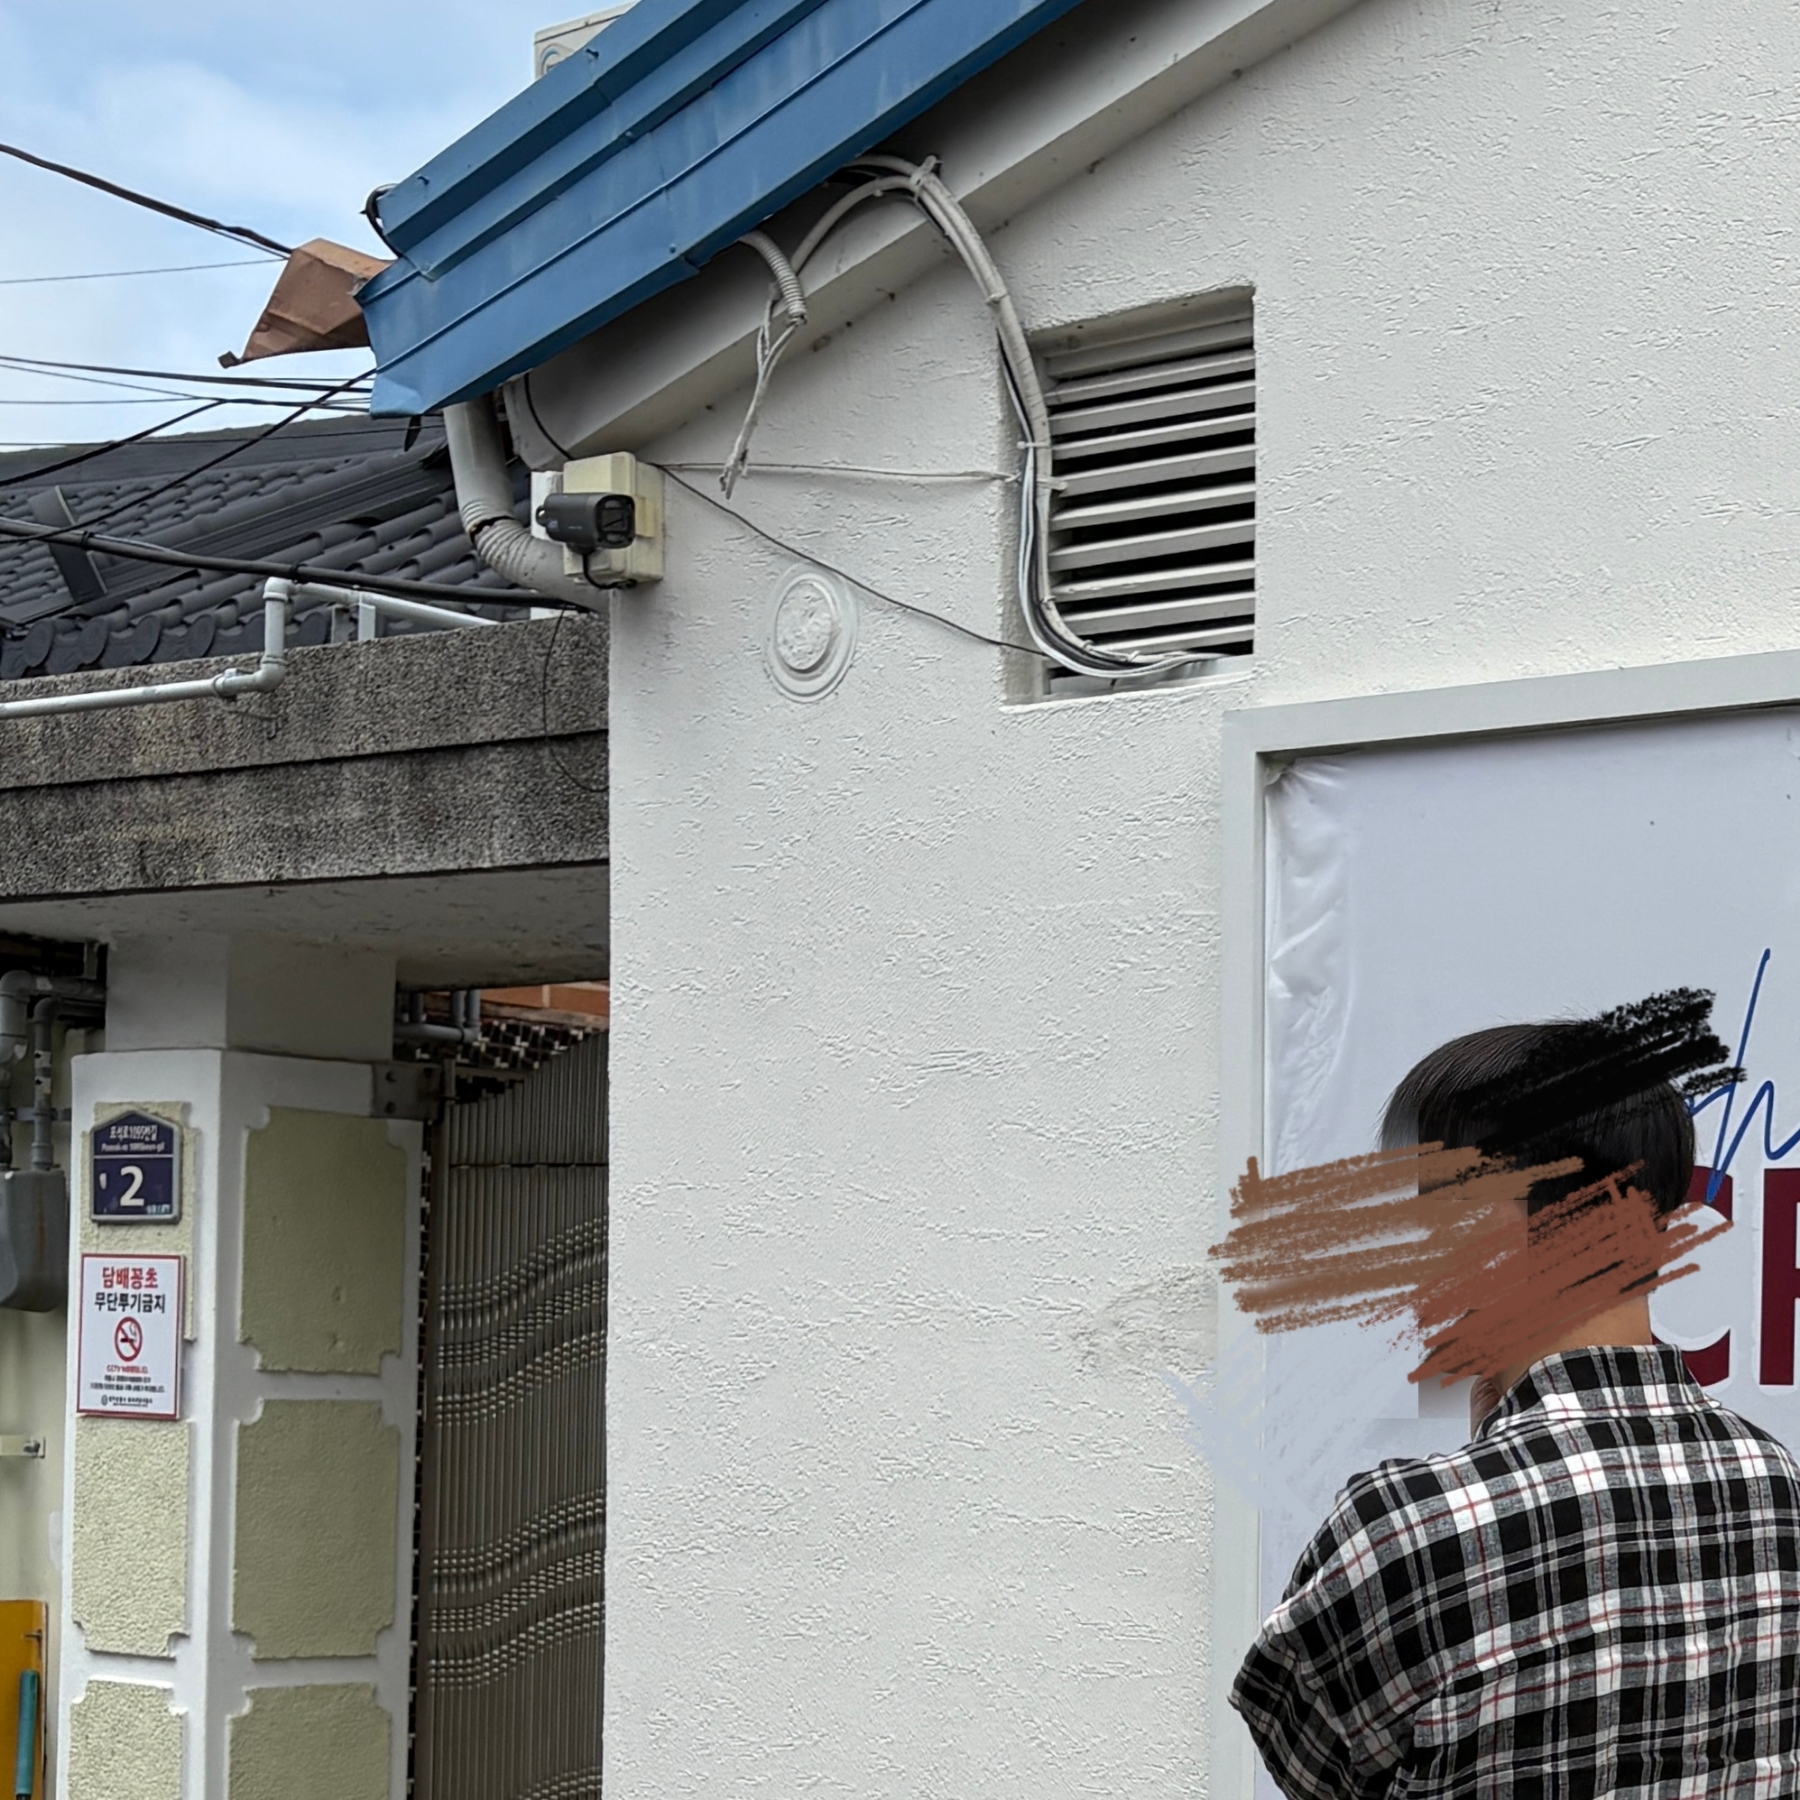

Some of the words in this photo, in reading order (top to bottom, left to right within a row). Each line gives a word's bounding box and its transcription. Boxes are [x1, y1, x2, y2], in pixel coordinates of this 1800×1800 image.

[119, 1165, 145, 1207] 2
[102, 1266, 159, 1290] 담배꽁초
[94, 1292, 166, 1314] 무단투기금지
